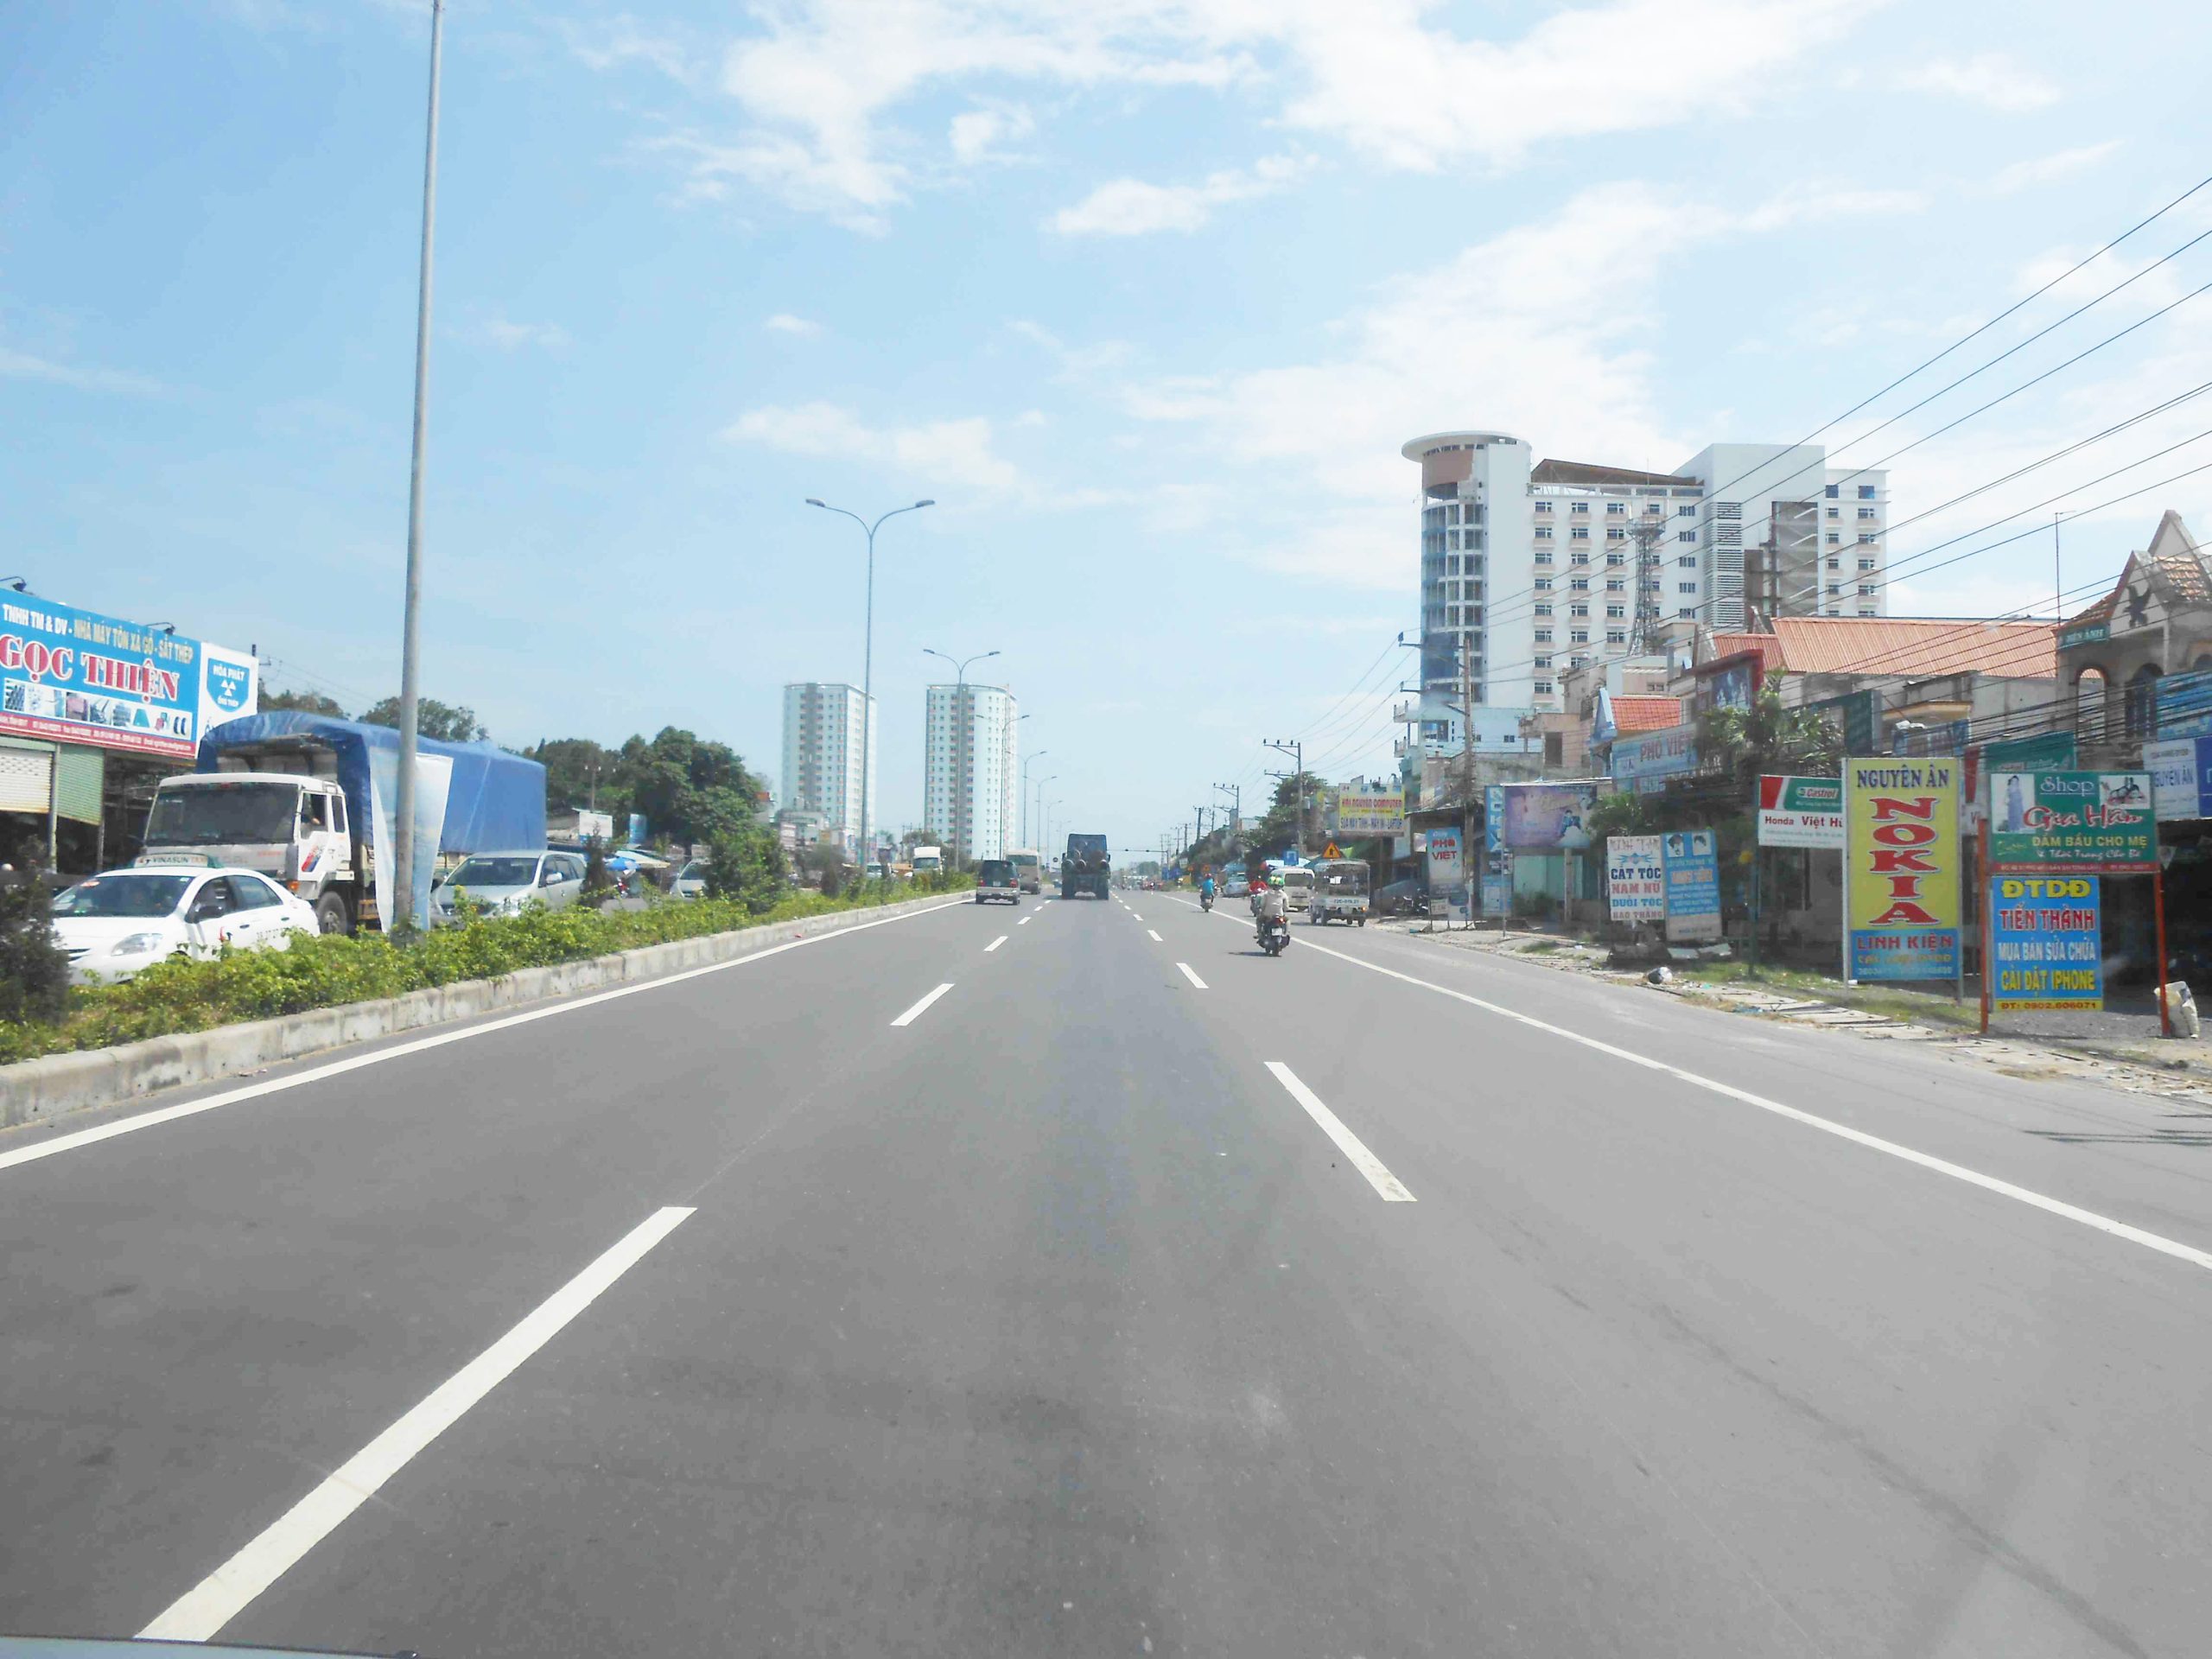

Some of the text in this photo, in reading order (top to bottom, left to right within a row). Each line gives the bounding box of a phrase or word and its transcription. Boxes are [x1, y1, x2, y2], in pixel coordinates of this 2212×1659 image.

[30, 611, 44, 631] TM
[54, 617, 67, 636] DV
[80, 652, 180, 703] THIỆN
[1926, 764, 1949, 788] ÂN
[2154, 766, 2180, 787] GUYÊN
[1807, 788, 1835, 798] Castrol
[2040, 777, 2094, 797] Shop
[1764, 816, 1794, 825] Honda
[1802, 816, 1825, 830] Việt
[2023, 805, 2081, 831] Gia
[2096, 836, 2124, 847] CHO
[2128, 836, 2148, 849] MẸ
[1869, 797, 1940, 925] NOKIA
[1638, 865, 1661, 879] TÓC
[1611, 883, 1639, 893] NAM
[2001, 880, 2091, 898] ĐTDĐ
[1999, 901, 2037, 931] TIẾN
[1858, 932, 1953, 951] LINH KIỆN
[1998, 942, 2020, 961] MUA
[2023, 937, 2044, 961] BÁN
[2046, 935, 2066, 961] SỬA
[2052, 969, 2095, 990] IPHONE
